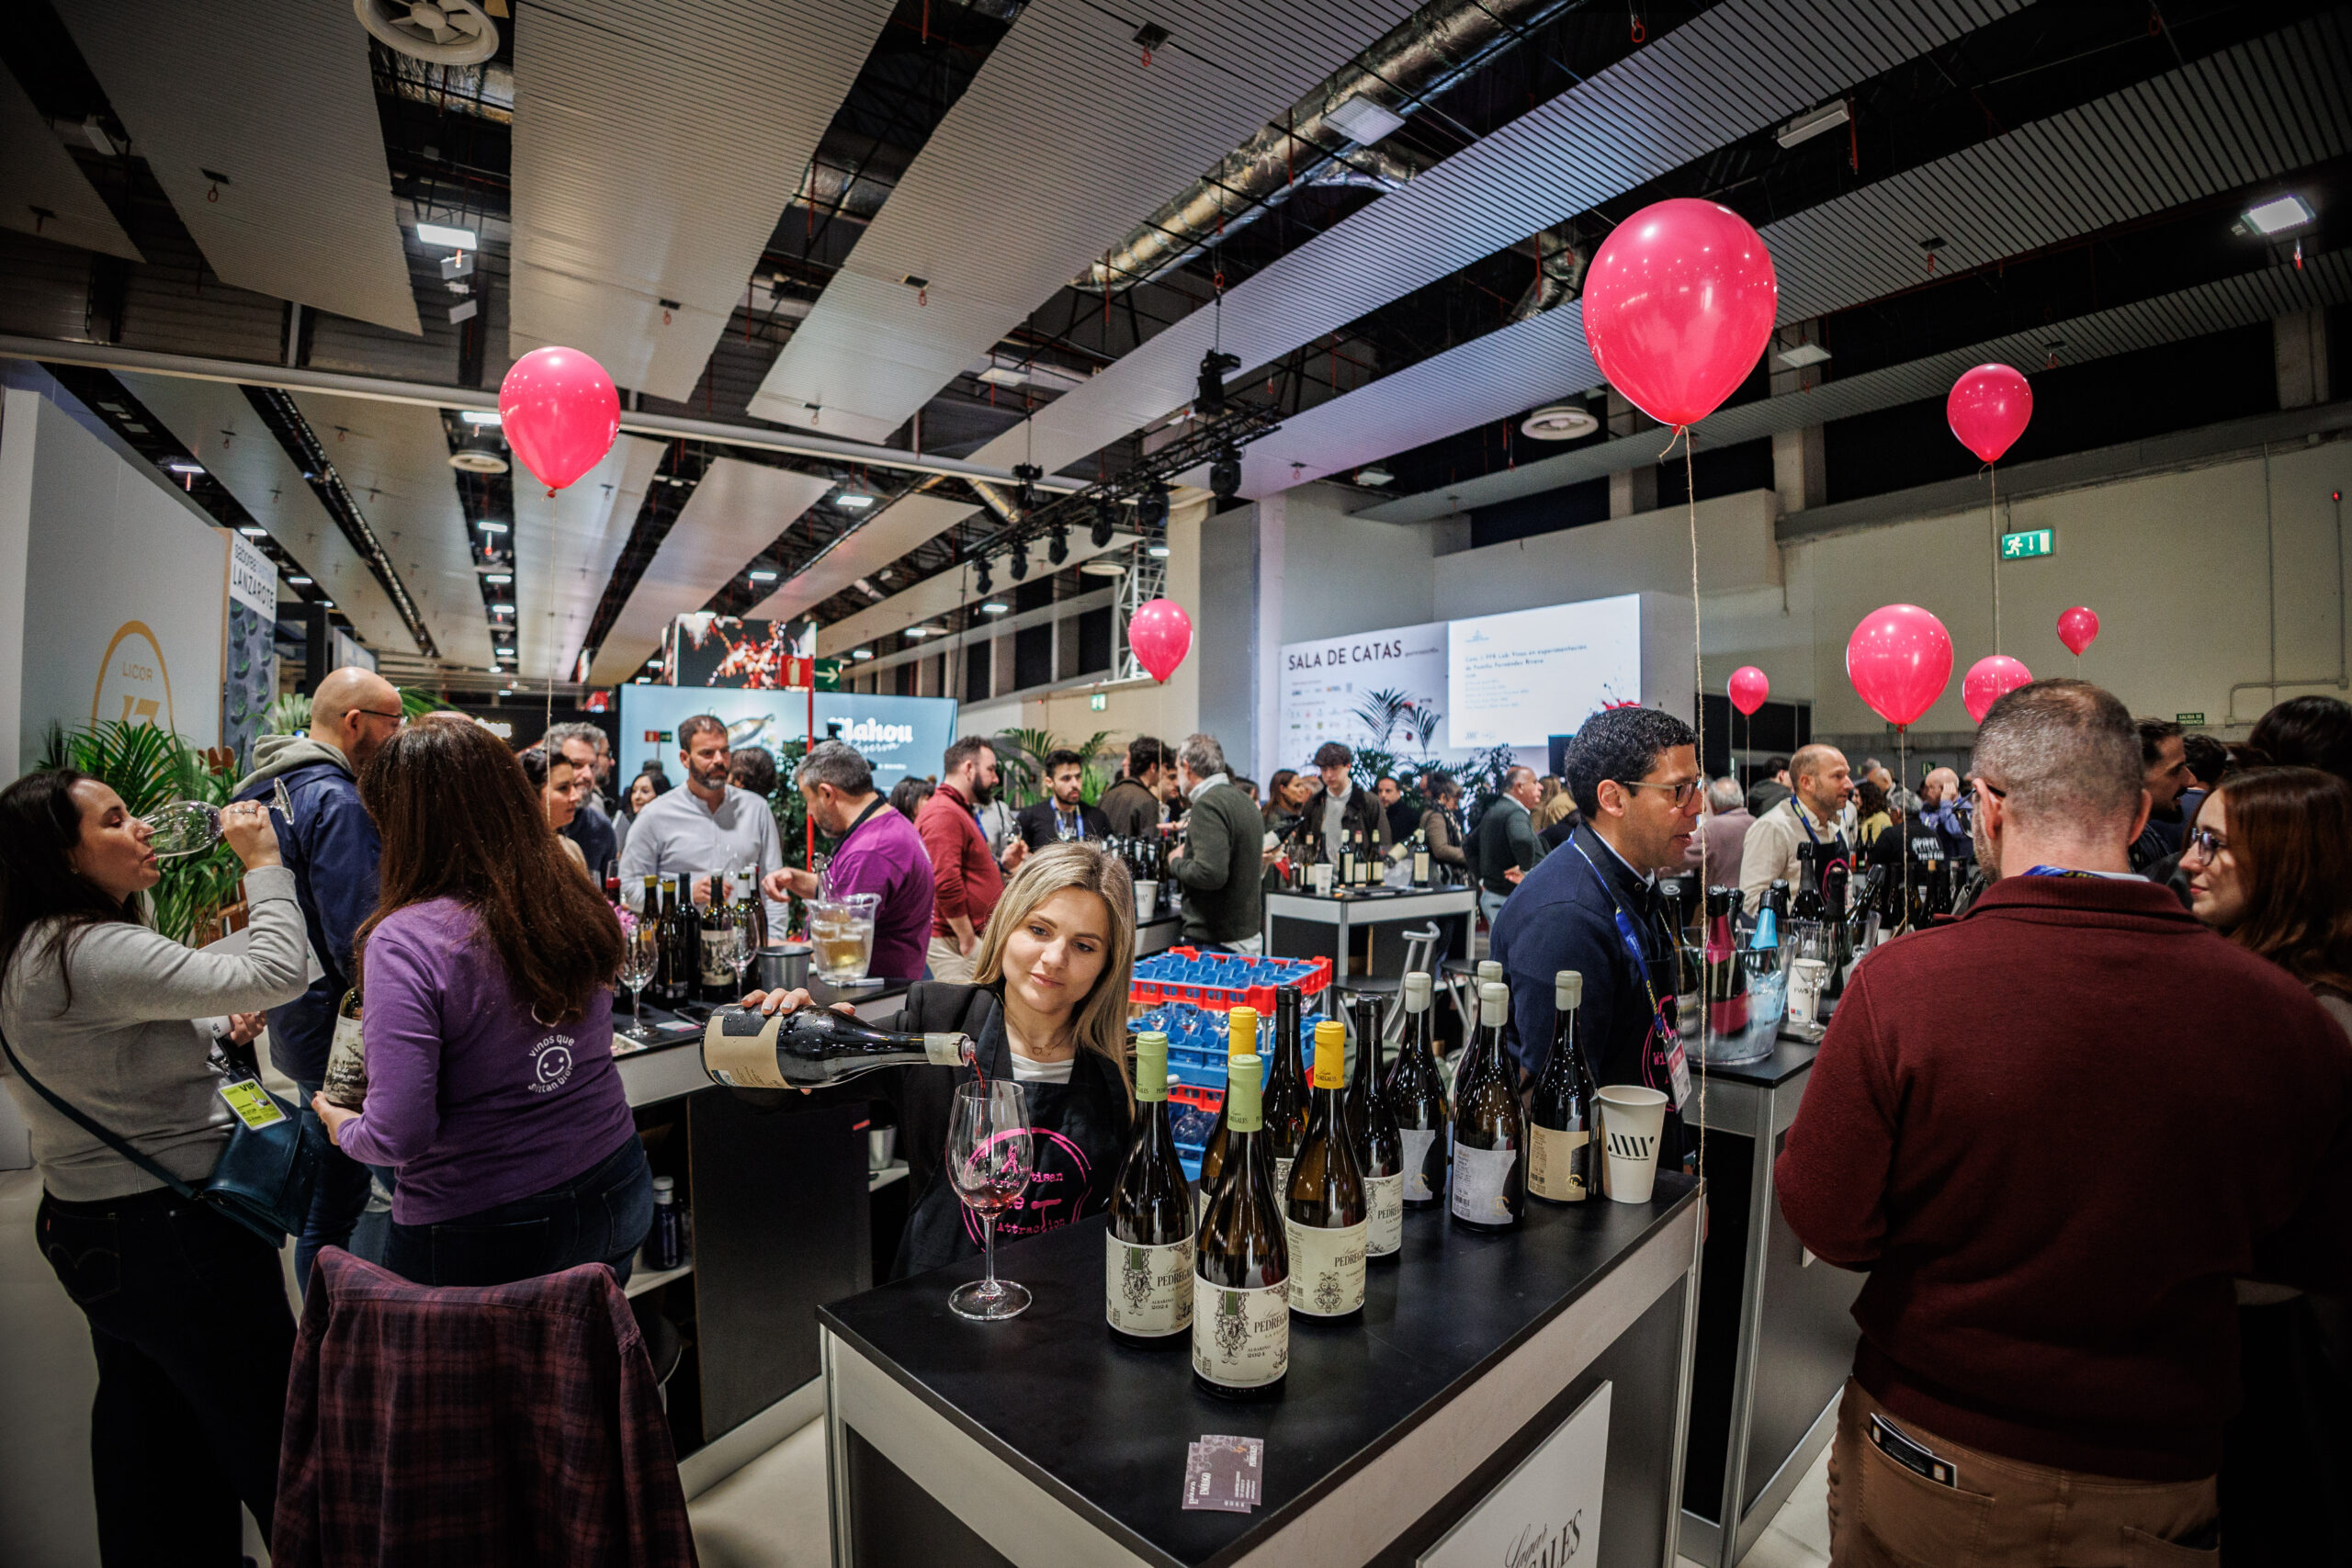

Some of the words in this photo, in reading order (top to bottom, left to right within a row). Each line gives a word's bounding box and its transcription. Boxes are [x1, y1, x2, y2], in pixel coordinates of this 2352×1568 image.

[232, 563, 275, 610] LANZAROTE
[1288, 652, 1322, 671] SALA
[1328, 648, 1347, 666] DE
[1351, 639, 1403, 662] CATAS
[121, 660, 153, 683] LICOR
[1645, 979, 1658, 1015] makro
[529, 1035, 555, 1058] vinos
[557, 1034, 575, 1047] que
[239, 1082, 256, 1093] VIP
